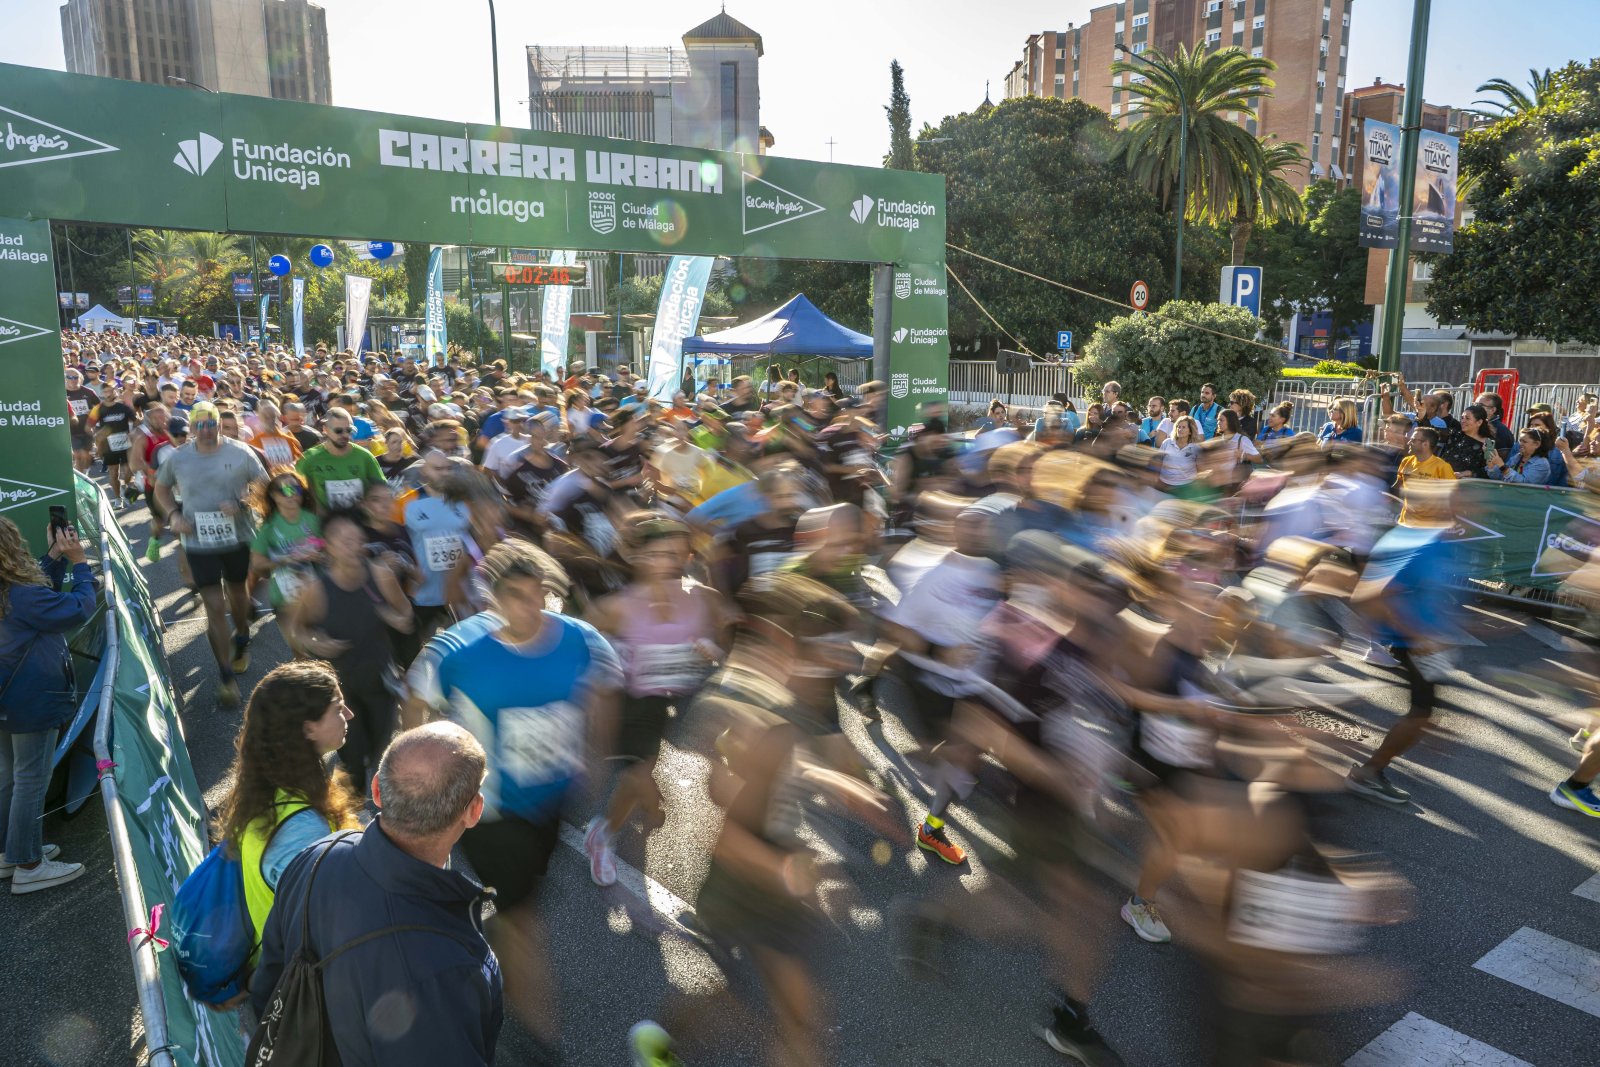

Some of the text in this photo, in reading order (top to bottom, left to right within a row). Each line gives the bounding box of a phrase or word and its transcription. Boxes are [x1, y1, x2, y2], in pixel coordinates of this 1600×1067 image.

[6, 122, 69, 152] Inglés
[231, 138, 351, 169] Fundación
[1369, 140, 1392, 158] TITANIC
[1424, 149, 1450, 167] TITANIC
[379, 129, 723, 194] CARRERA URBANA
[233, 160, 321, 190] Unicaja
[621, 202, 660, 216] Ciudad
[755, 197, 775, 209] Corte
[775, 195, 803, 215] Inglés
[877, 199, 936, 216] Fundación
[622, 217, 675, 233] de Málaga
[877, 213, 920, 232] Unicaja
[505, 266, 570, 284] 0:02:46
[914, 278, 937, 286] Ciudad
[914, 286, 946, 296] de Málaga
[1135, 290, 1146, 300] 20
[1236, 274, 1254, 307] P
[427, 272, 435, 331] Fundación
[659, 259, 690, 342] Fundación
[434, 290, 443, 332] Unicaja
[673, 286, 699, 345] Unicaja
[910, 328, 948, 336] Fundación
[910, 336, 938, 345] Unicaja
[1060, 333, 1069, 347] P
[912, 377, 937, 385] Ciudad
[912, 386, 947, 395] de Málaga
[12, 414, 65, 427] Málaga
[200, 523, 232, 536] 5565
